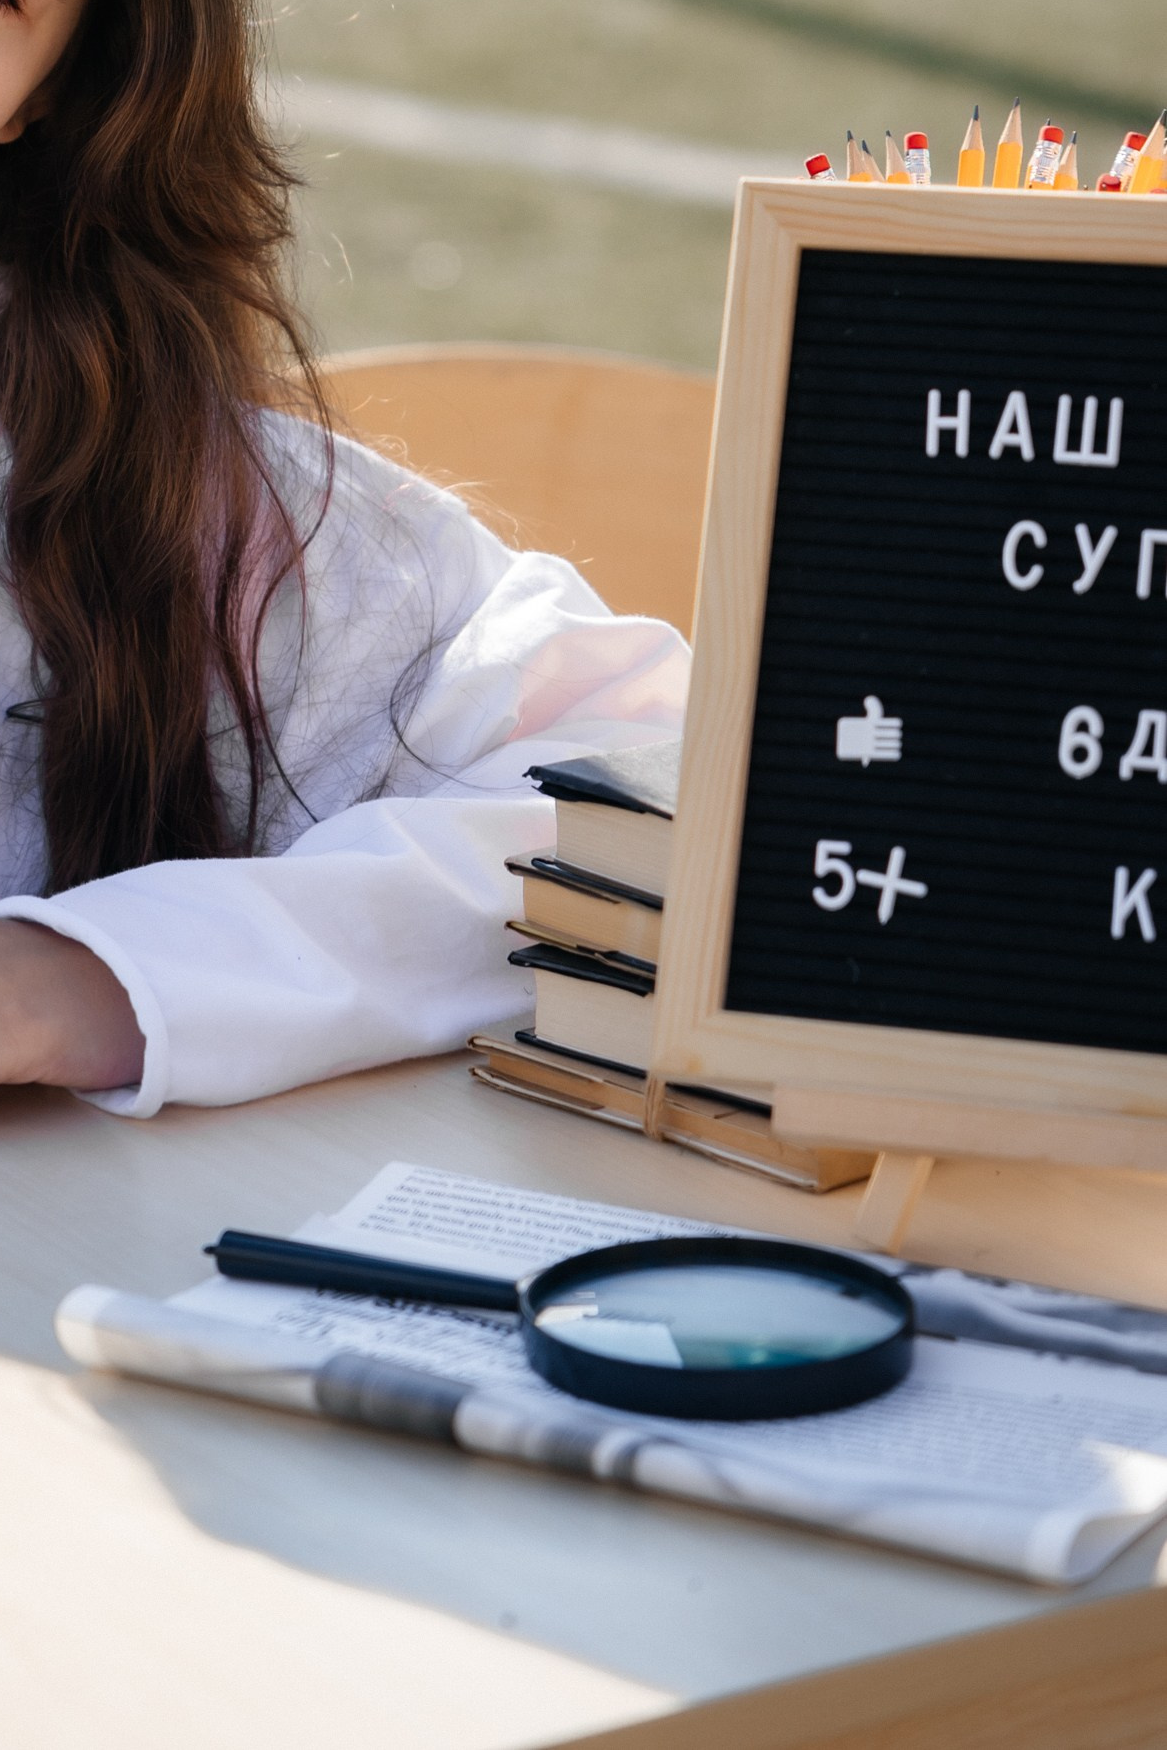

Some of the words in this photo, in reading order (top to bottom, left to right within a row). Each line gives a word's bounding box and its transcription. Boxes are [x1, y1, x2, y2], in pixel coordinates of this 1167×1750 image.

[924, 387, 1125, 468] НАШ
[1000, 518, 1167, 600] СУП
[1109, 864, 1158, 943] К
